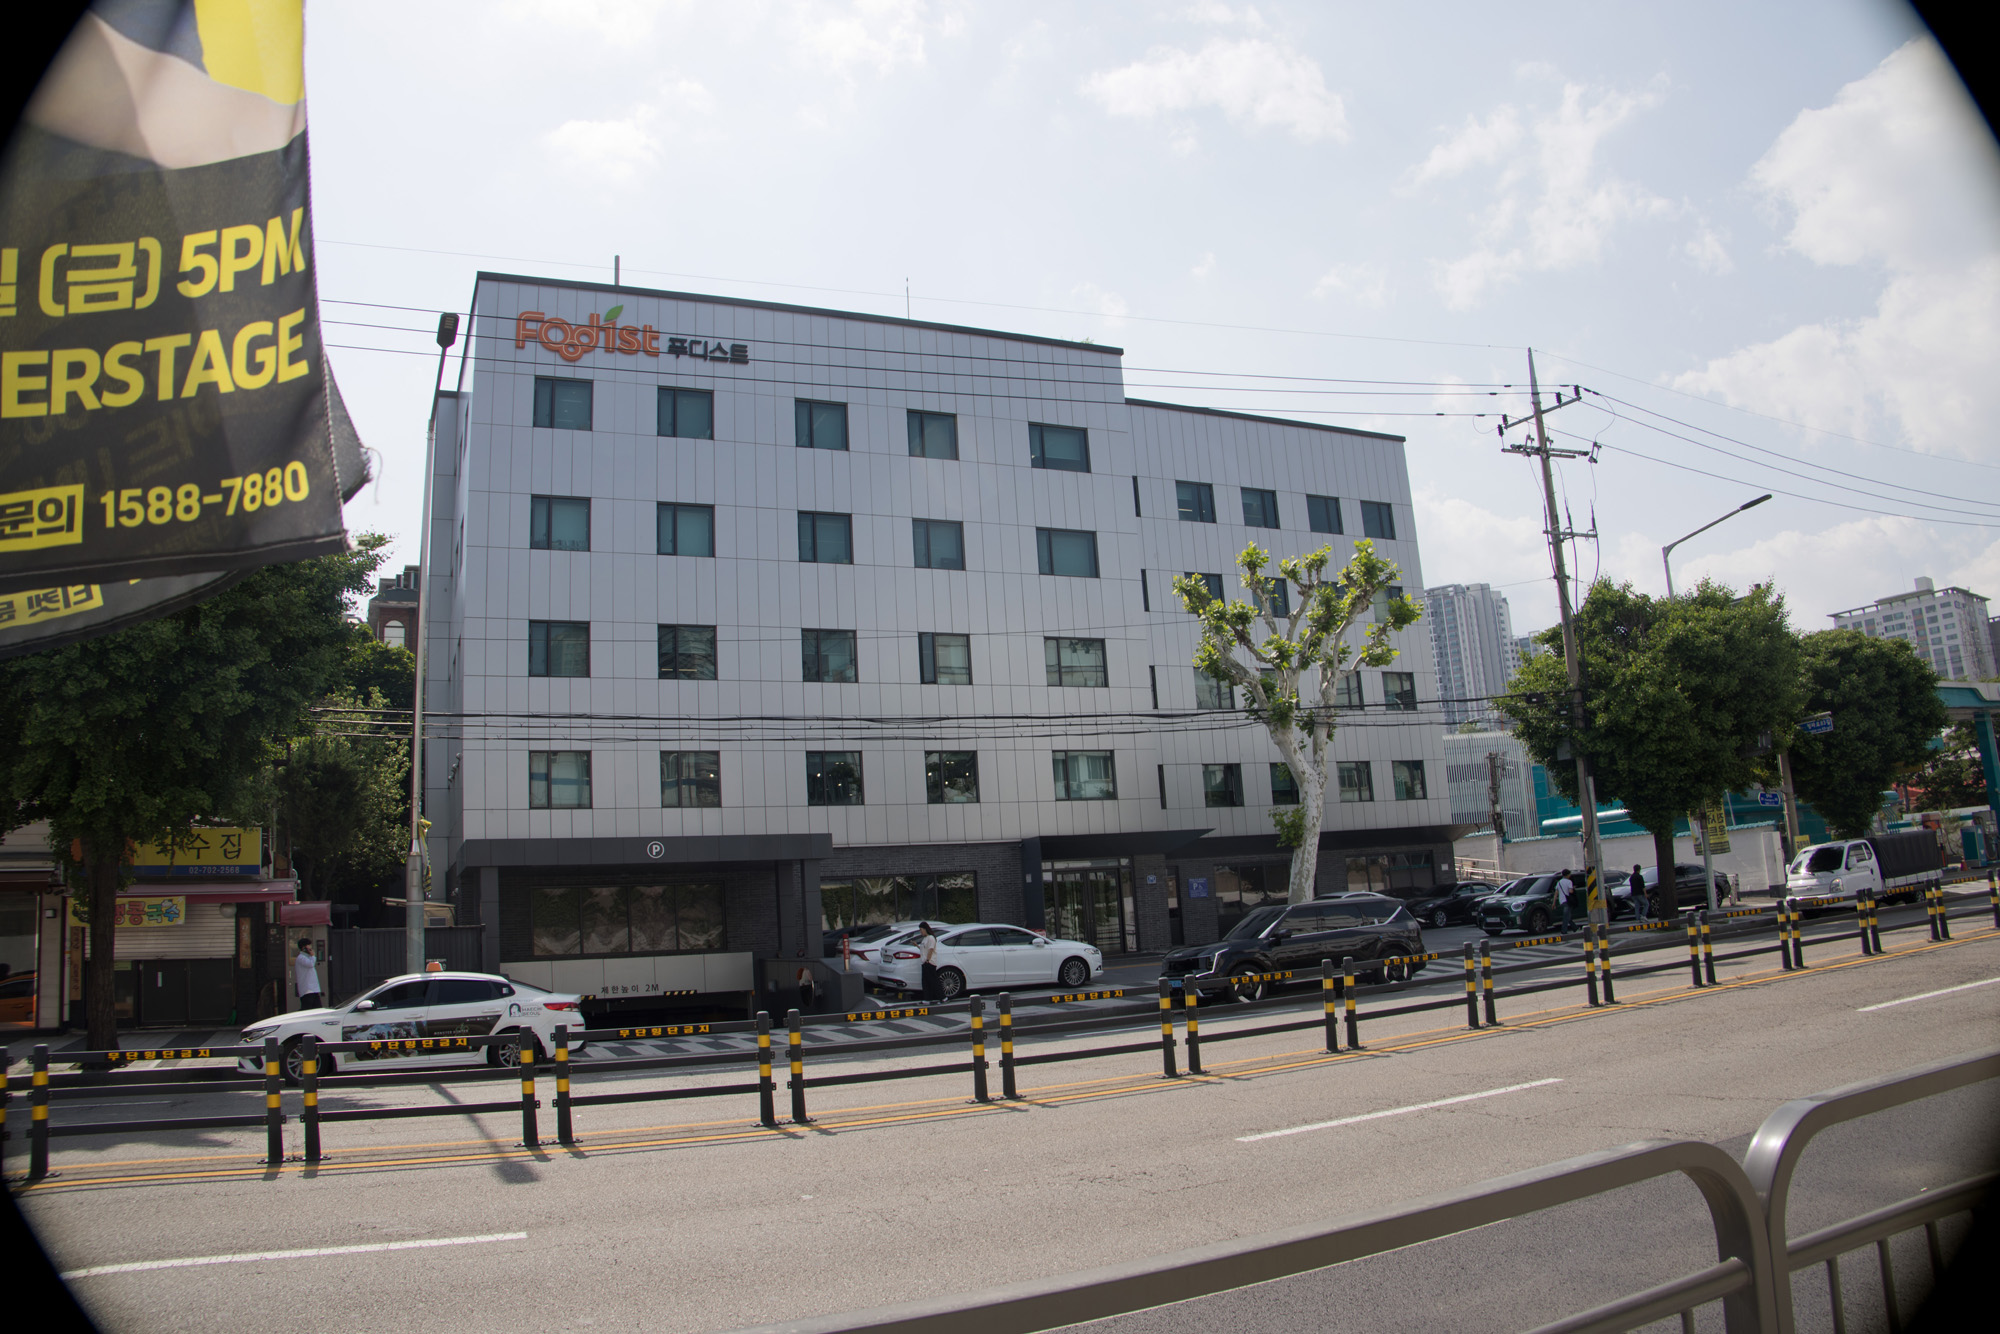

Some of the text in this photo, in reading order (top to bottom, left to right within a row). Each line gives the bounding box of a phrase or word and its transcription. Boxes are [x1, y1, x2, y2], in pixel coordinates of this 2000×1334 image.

[39, 236, 162, 317] (금)
[177, 207, 306, 298] 5PM
[667, 337, 750, 364] 푸디스트
[1, 308, 309, 418] ERSTAGE
[100, 461, 309, 529] 1588-7880
[188, 866, 240, 874] 02-702-2568
[600, 983, 659, 993] 제한높이 2M
[1051, 989, 1124, 1004] 무단횡단금지
[847, 1007, 929, 1022] 무단횡단금지
[619, 1023, 710, 1038] 무단횡단금지
[371, 1037, 468, 1051] 무단횡단금지
[108, 1048, 210, 1061] 무단횡단금지
